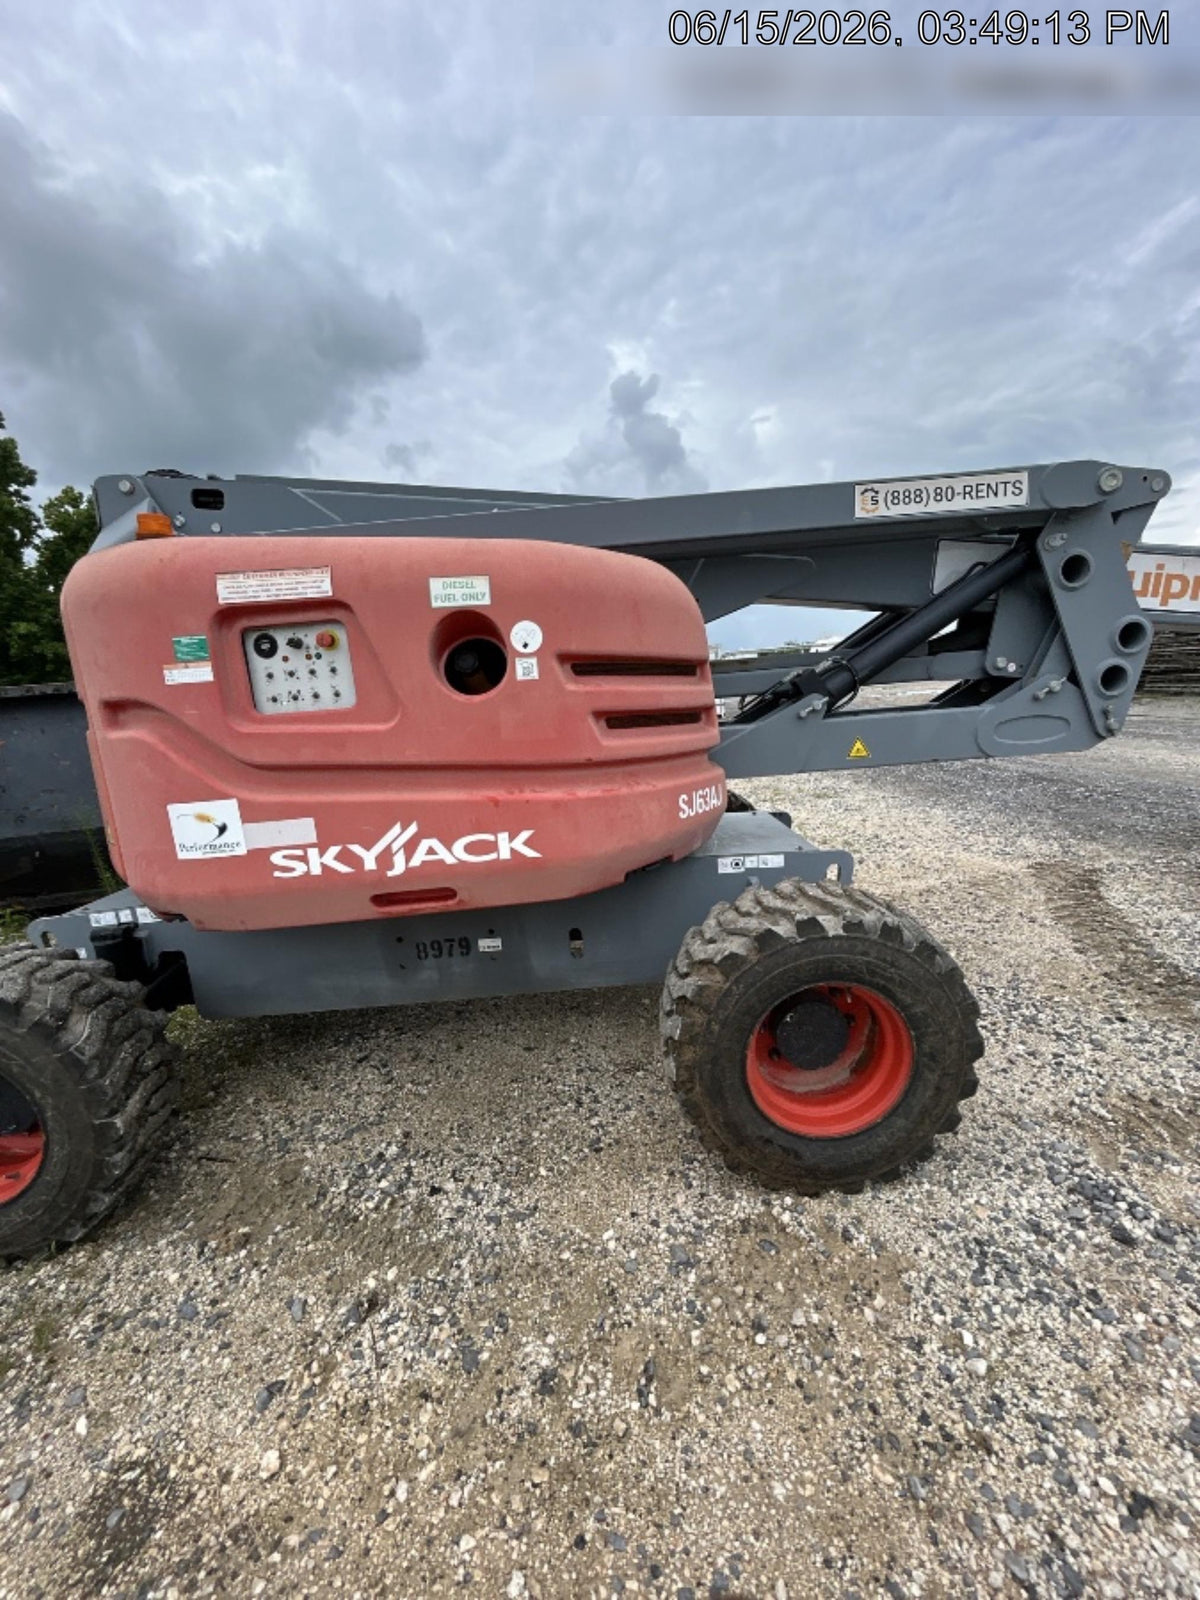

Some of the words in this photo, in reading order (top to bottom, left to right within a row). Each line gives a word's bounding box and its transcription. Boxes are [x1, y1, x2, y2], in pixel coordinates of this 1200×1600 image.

[433, 593, 459, 603] FUEL
[462, 591, 486, 602] ONLY
[442, 580, 476, 590] DIESEL
[1128, 563, 1200, 607] uip
[679, 784, 722, 818] SJ63AJ
[269, 820, 543, 877] SKYJACK
[416, 937, 471, 960] 8979
